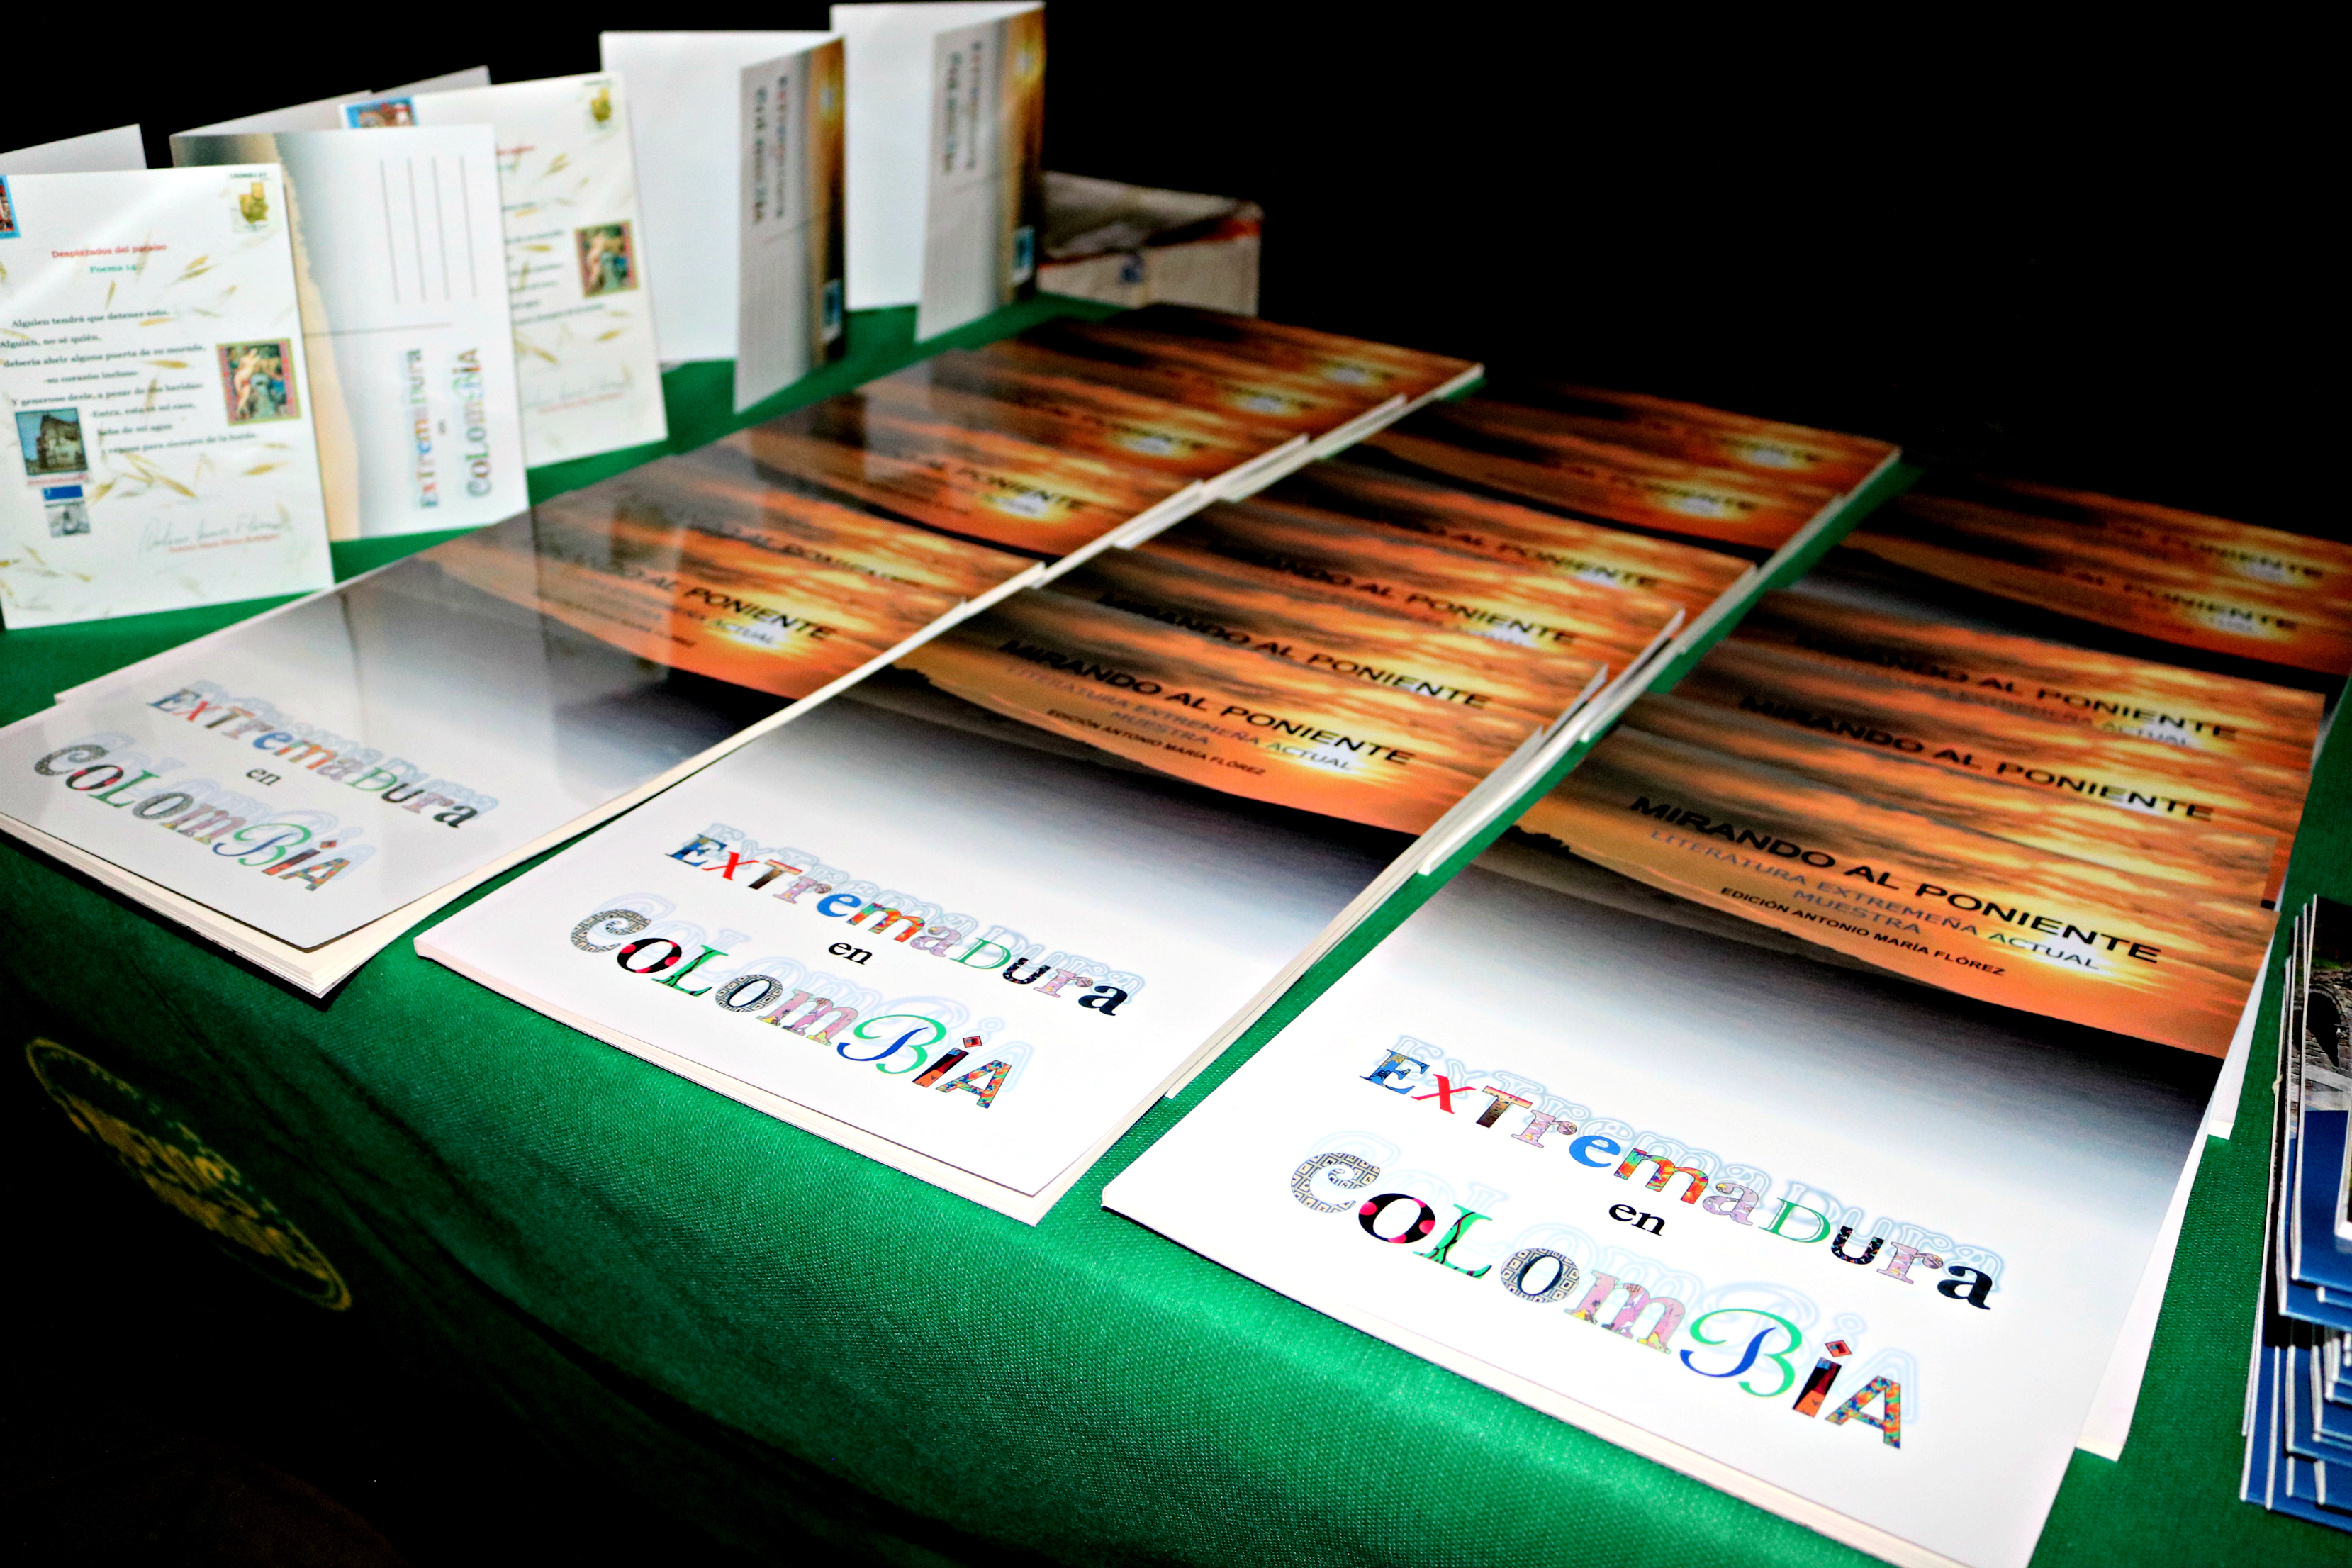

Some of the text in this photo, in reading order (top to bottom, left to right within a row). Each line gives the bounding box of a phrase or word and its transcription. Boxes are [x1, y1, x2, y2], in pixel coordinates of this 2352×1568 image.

[12, 318, 49, 327] Alguien
[52, 315, 84, 324] tendrá
[683, 586, 836, 640] PONIENTE
[1406, 593, 1575, 644] PONIENTE
[1255, 642, 1297, 658] AL
[1308, 653, 1491, 709] PONIENTE
[999, 640, 1415, 766] MIRANDO AL PONIENTE
[2037, 688, 2238, 742] PONIENTE
[1101, 726, 1163, 746] ANTONIO
[1266, 742, 1351, 771] ACTUAL
[1740, 696, 2214, 822] MIRANDO AL PONIENTE
[246, 766, 281, 786] en
[1630, 796, 2162, 964] MIRANDO AL PONIENTE
[1651, 830, 2100, 970] LITERATURA EXTREMEÑA ACTUAL
[1721, 887, 2006, 976] EDICIÓN ANTONIO MARÍA FLÓREZ
[1793, 890, 1920, 934] MUESTRA
[828, 941, 873, 965] en
[1608, 1203, 1667, 1236] en
